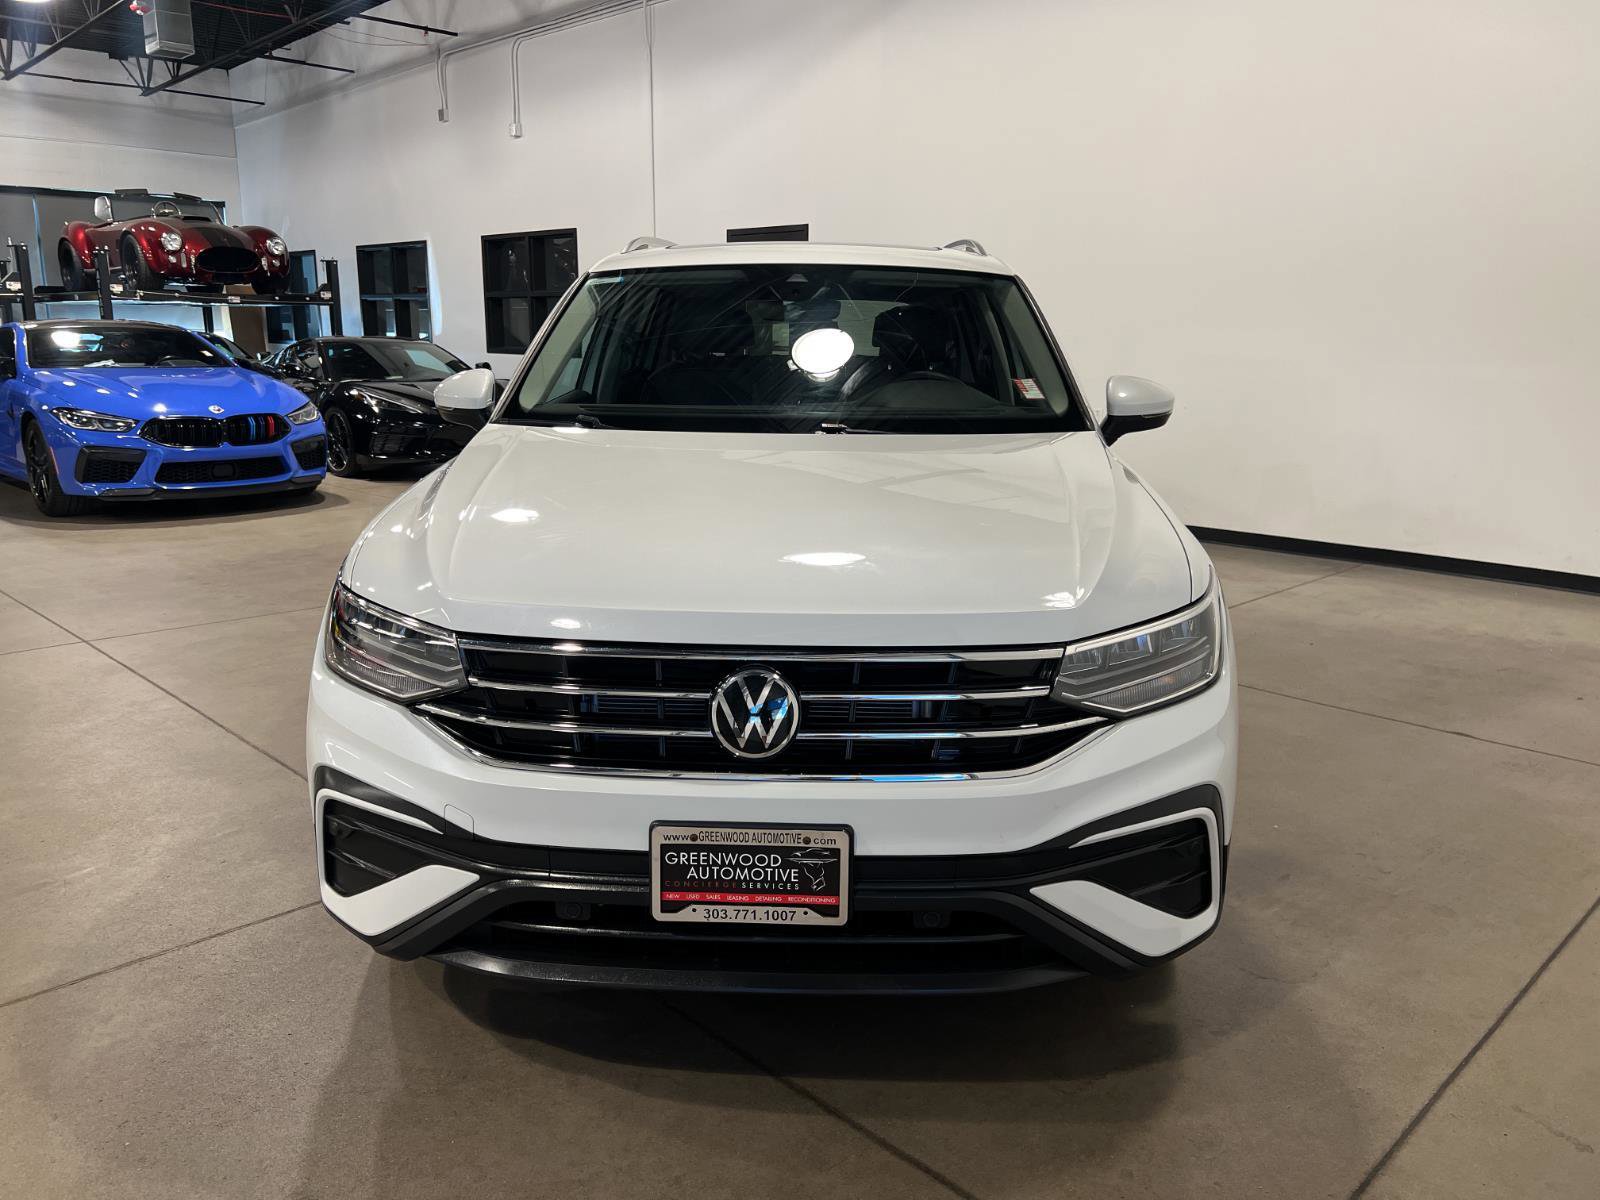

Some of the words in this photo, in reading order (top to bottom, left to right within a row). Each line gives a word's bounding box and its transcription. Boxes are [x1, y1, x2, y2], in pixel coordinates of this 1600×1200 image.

[698, 831, 750, 843] GREENWOOD
[751, 832, 802, 844] AUTOMOTIVE
[664, 852, 782, 867] GREENWOOD
[686, 866, 799, 882] AUTOMOTIVE
[741, 882, 800, 890] SERVICES
[703, 908, 797, 921] 303.771.1007
